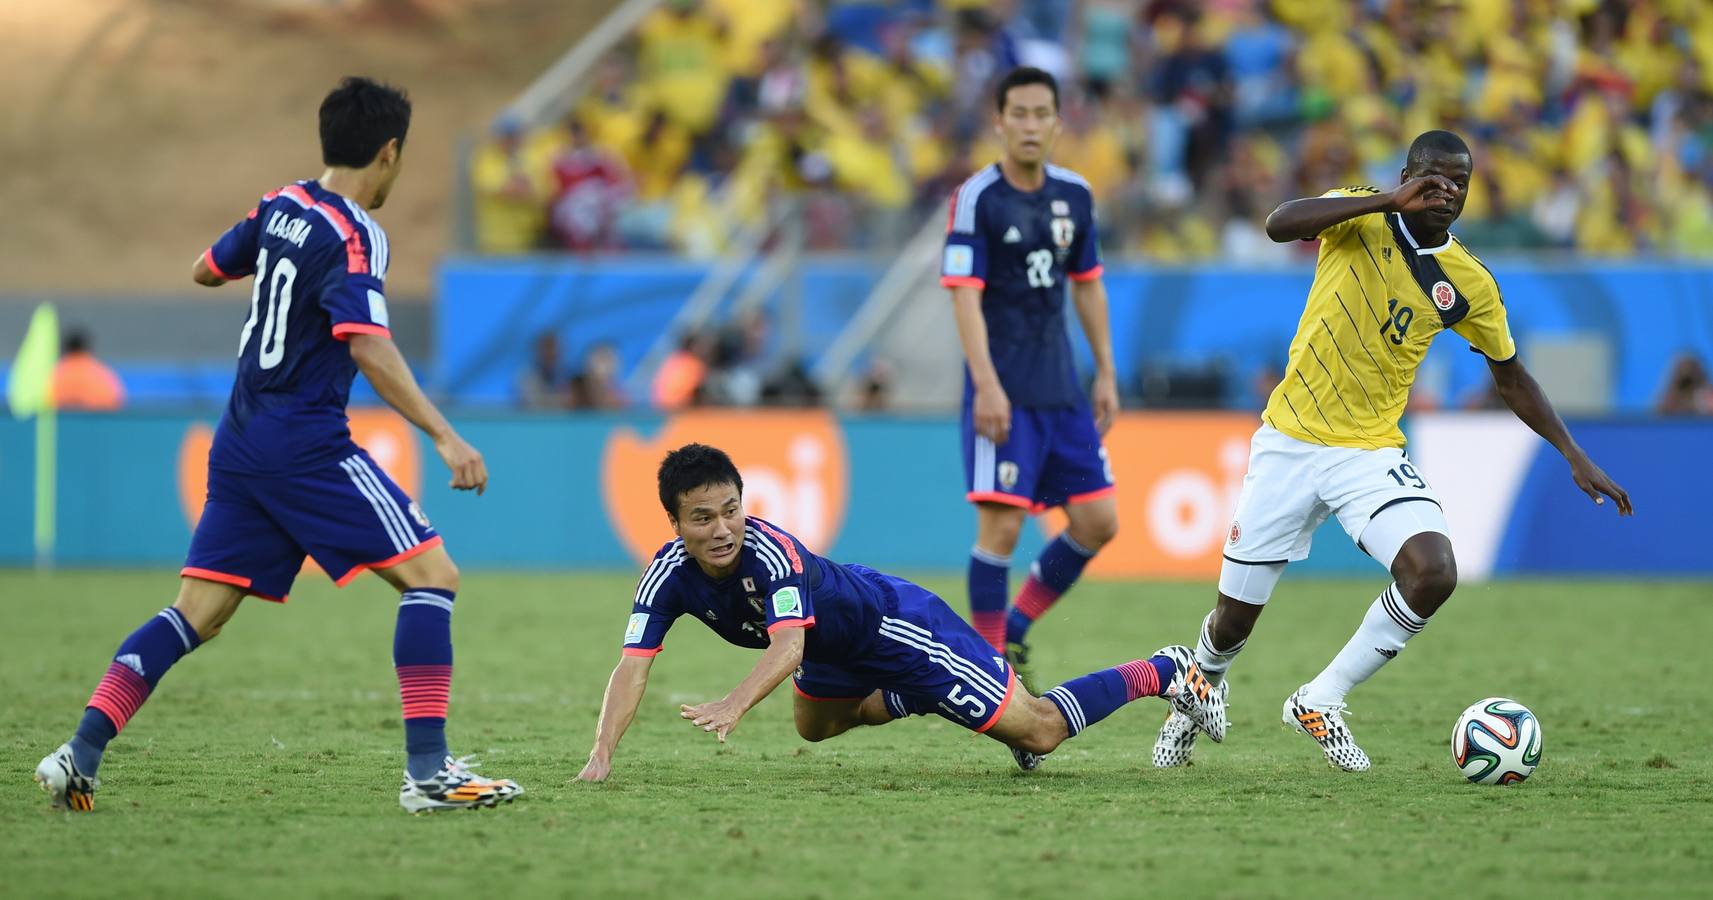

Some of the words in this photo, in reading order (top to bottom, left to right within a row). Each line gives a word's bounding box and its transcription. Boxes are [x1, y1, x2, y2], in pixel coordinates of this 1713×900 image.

[238, 247, 297, 369] 10
[1379, 298, 1413, 345] 19
[1387, 464, 1426, 489] 19
